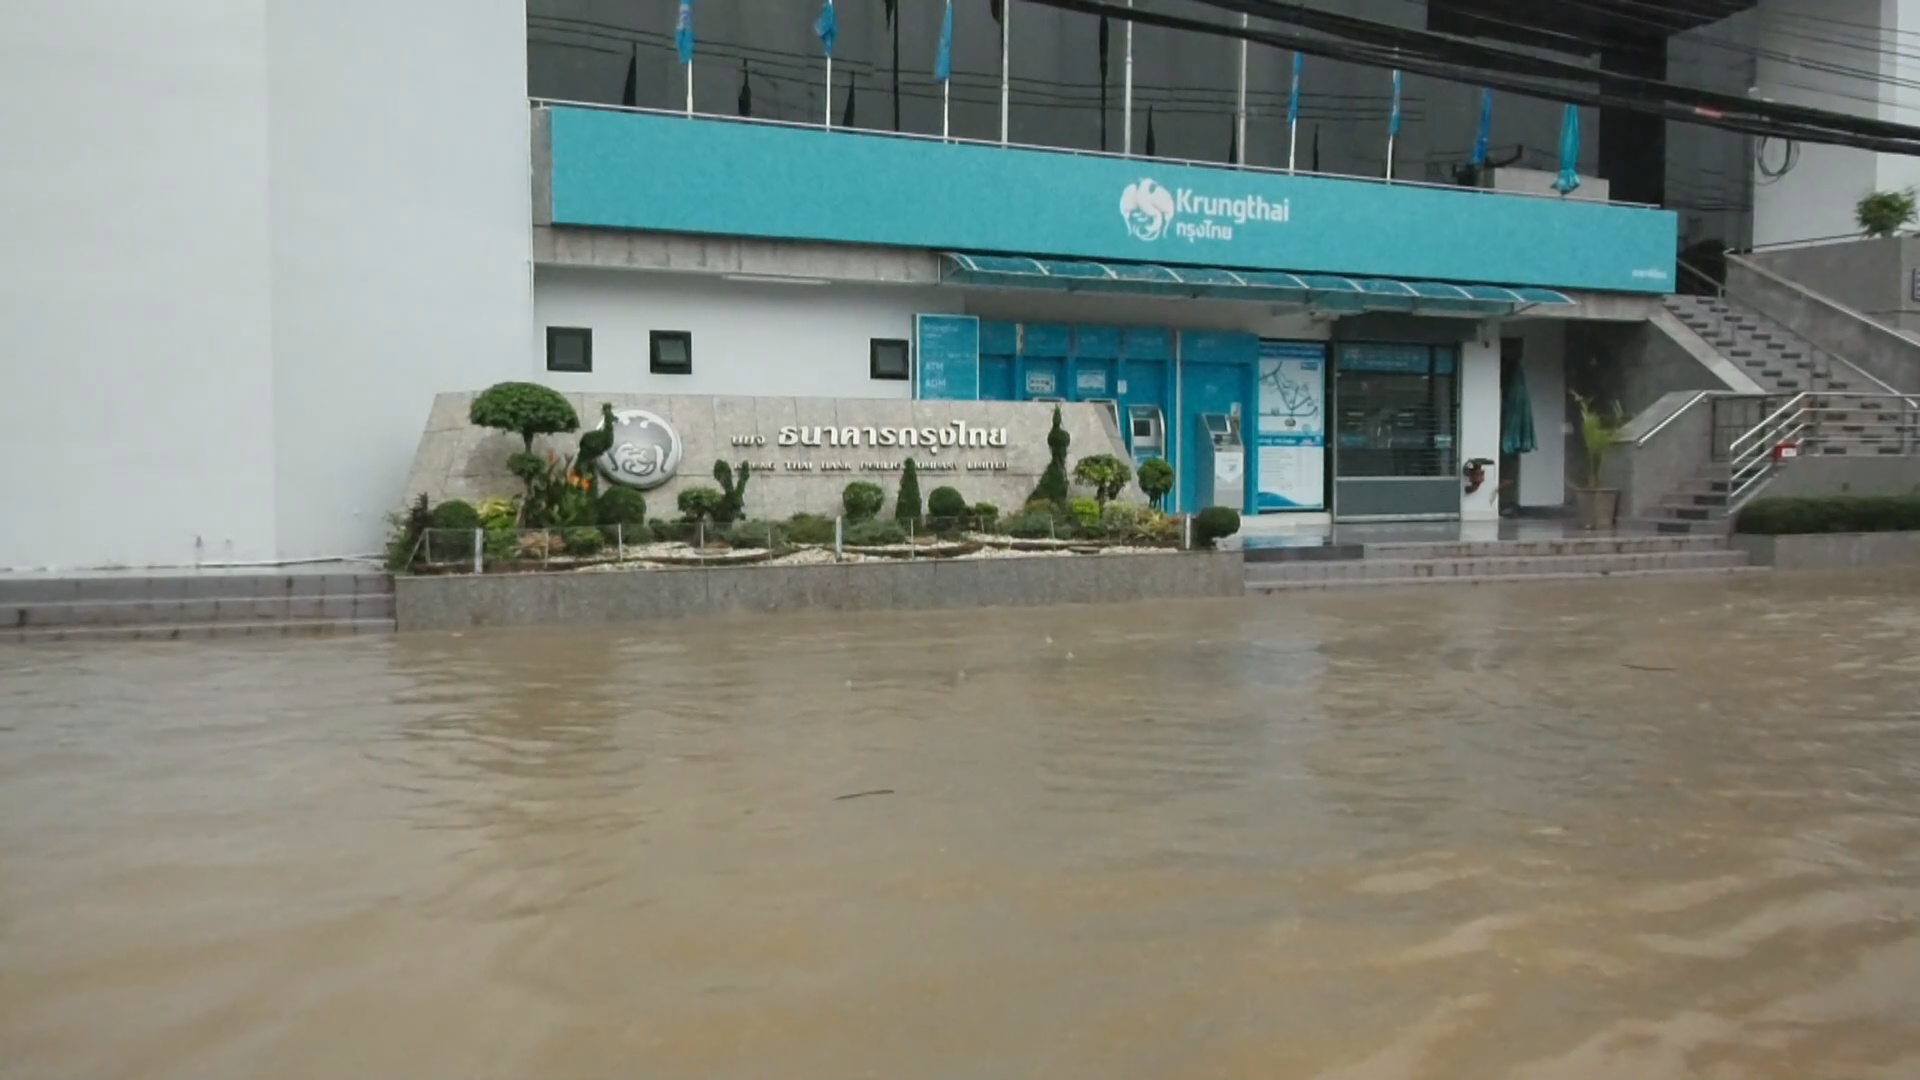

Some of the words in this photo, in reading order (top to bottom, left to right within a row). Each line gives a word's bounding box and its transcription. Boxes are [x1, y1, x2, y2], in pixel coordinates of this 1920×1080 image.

[1176, 187, 1290, 224] Krungthai
[1176, 219, 1233, 244] กรุงไทย
[778, 419, 1007, 454] ธนาคารกรุงไทย
[734, 461, 776, 471] KUNG
[784, 461, 813, 471] THAI
[902, 461, 958, 471] OMPANY
